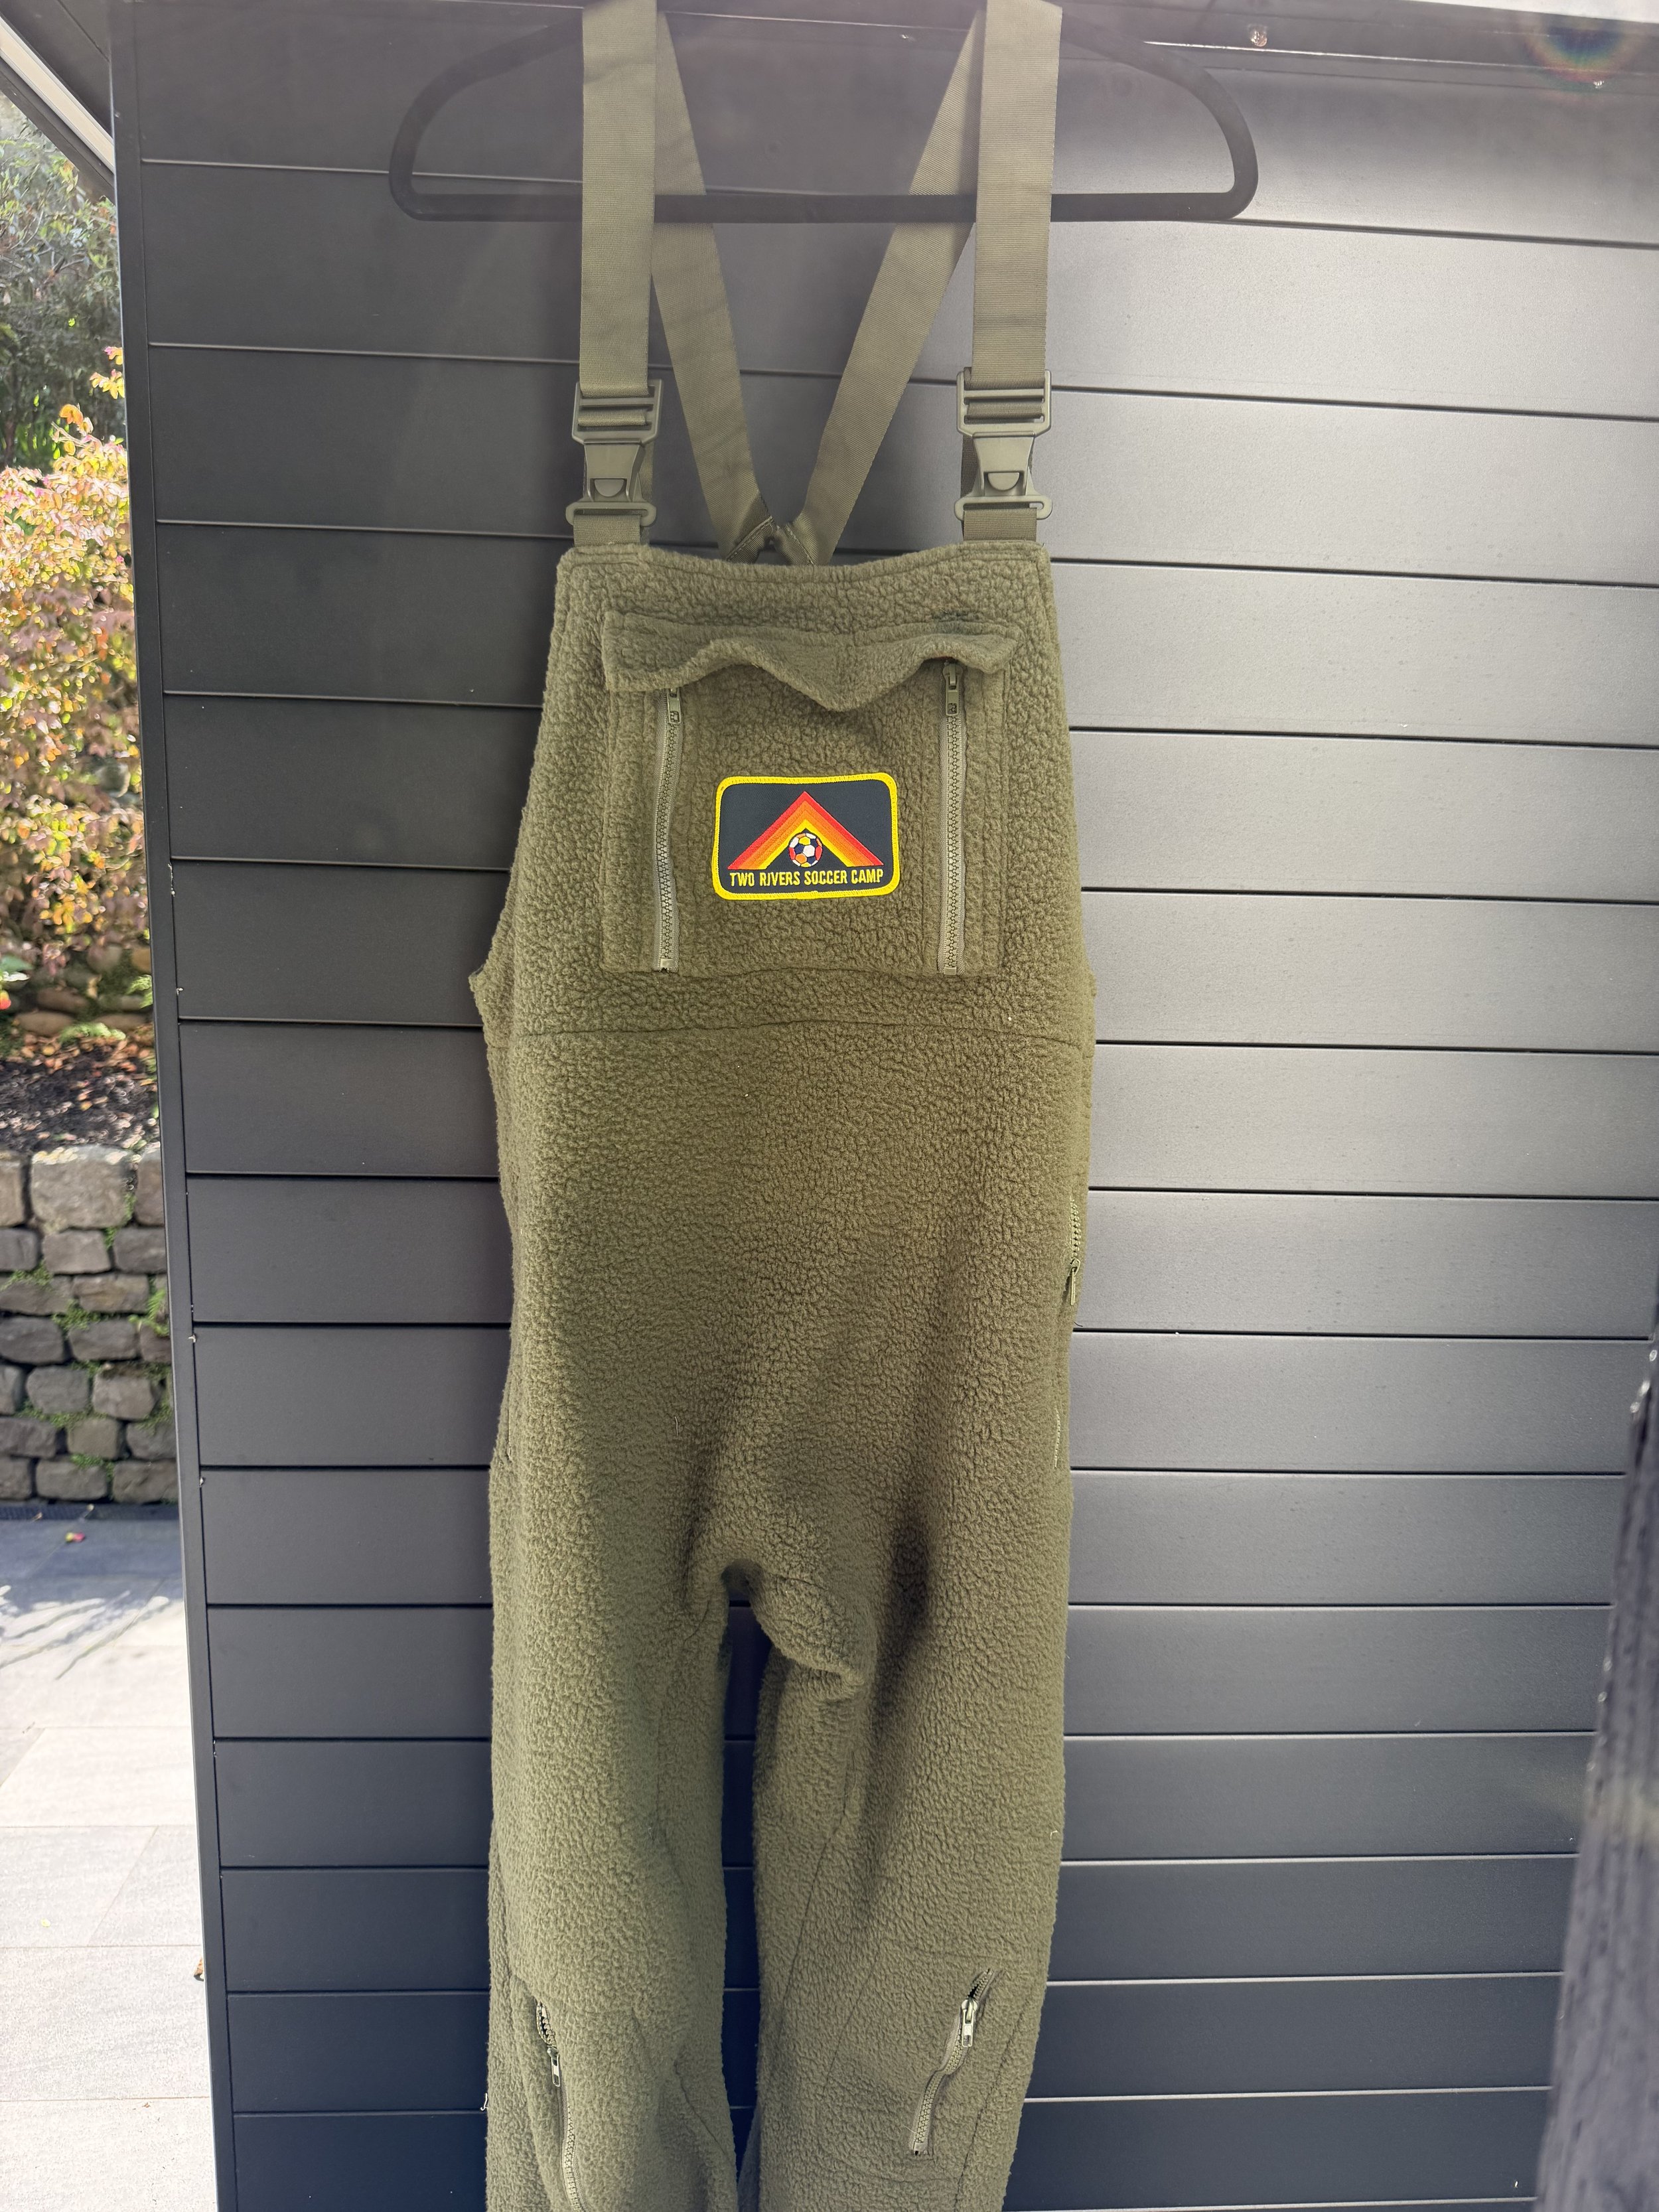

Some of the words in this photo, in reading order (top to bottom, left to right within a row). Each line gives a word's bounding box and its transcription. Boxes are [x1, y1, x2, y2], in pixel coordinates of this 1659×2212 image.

[729, 872, 755, 887] TWO
[760, 871, 800, 887] RIVERS
[804, 870, 847, 885] SOCCER
[851, 868, 883, 884] CAMP
